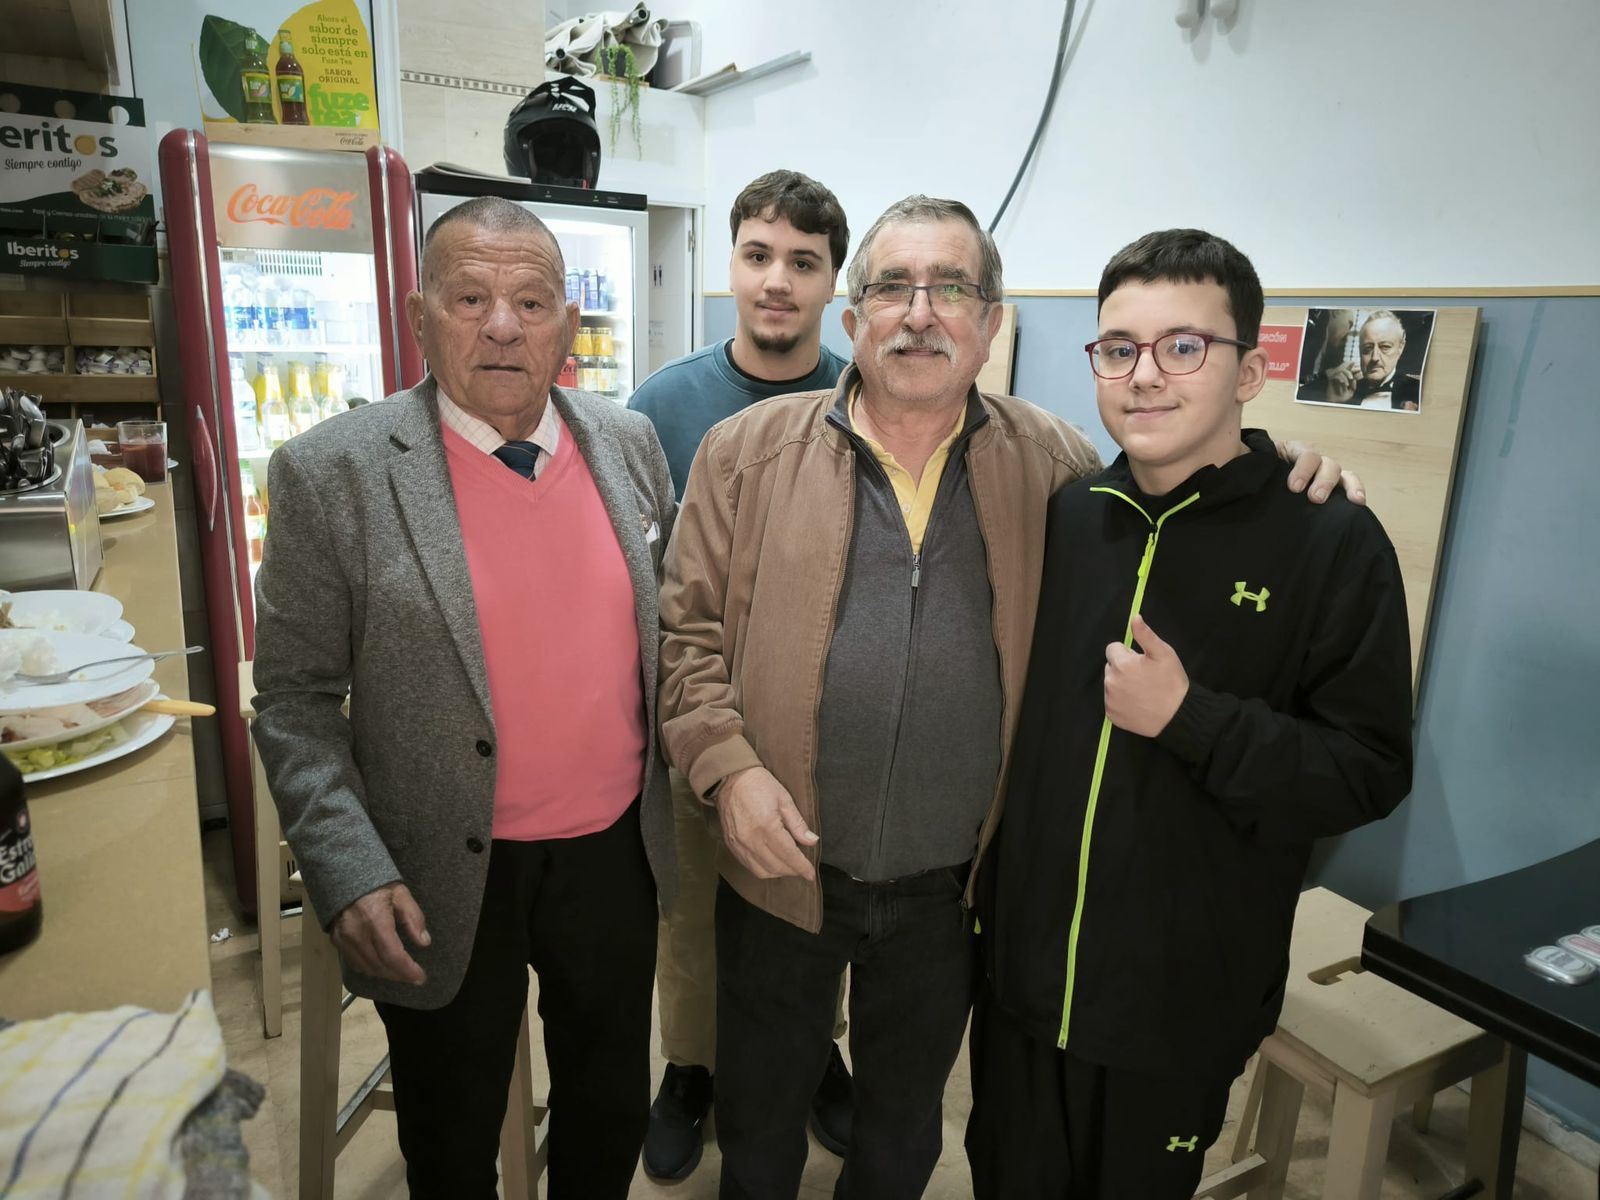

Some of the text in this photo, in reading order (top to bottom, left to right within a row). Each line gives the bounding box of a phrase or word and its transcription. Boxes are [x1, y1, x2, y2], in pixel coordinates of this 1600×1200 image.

[317, 14, 339, 22] Ahora
[309, 23, 358, 36] sabor de
[311, 34, 358, 47] siempre
[302, 44, 368, 58] solo está en
[324, 68, 352, 76] SABOR
[318, 75, 360, 85] ORIGINAL
[308, 83, 369, 111] fuze
[4, 157, 82, 173] Siempre contigo
[7, 241, 79, 259] Iberitos
